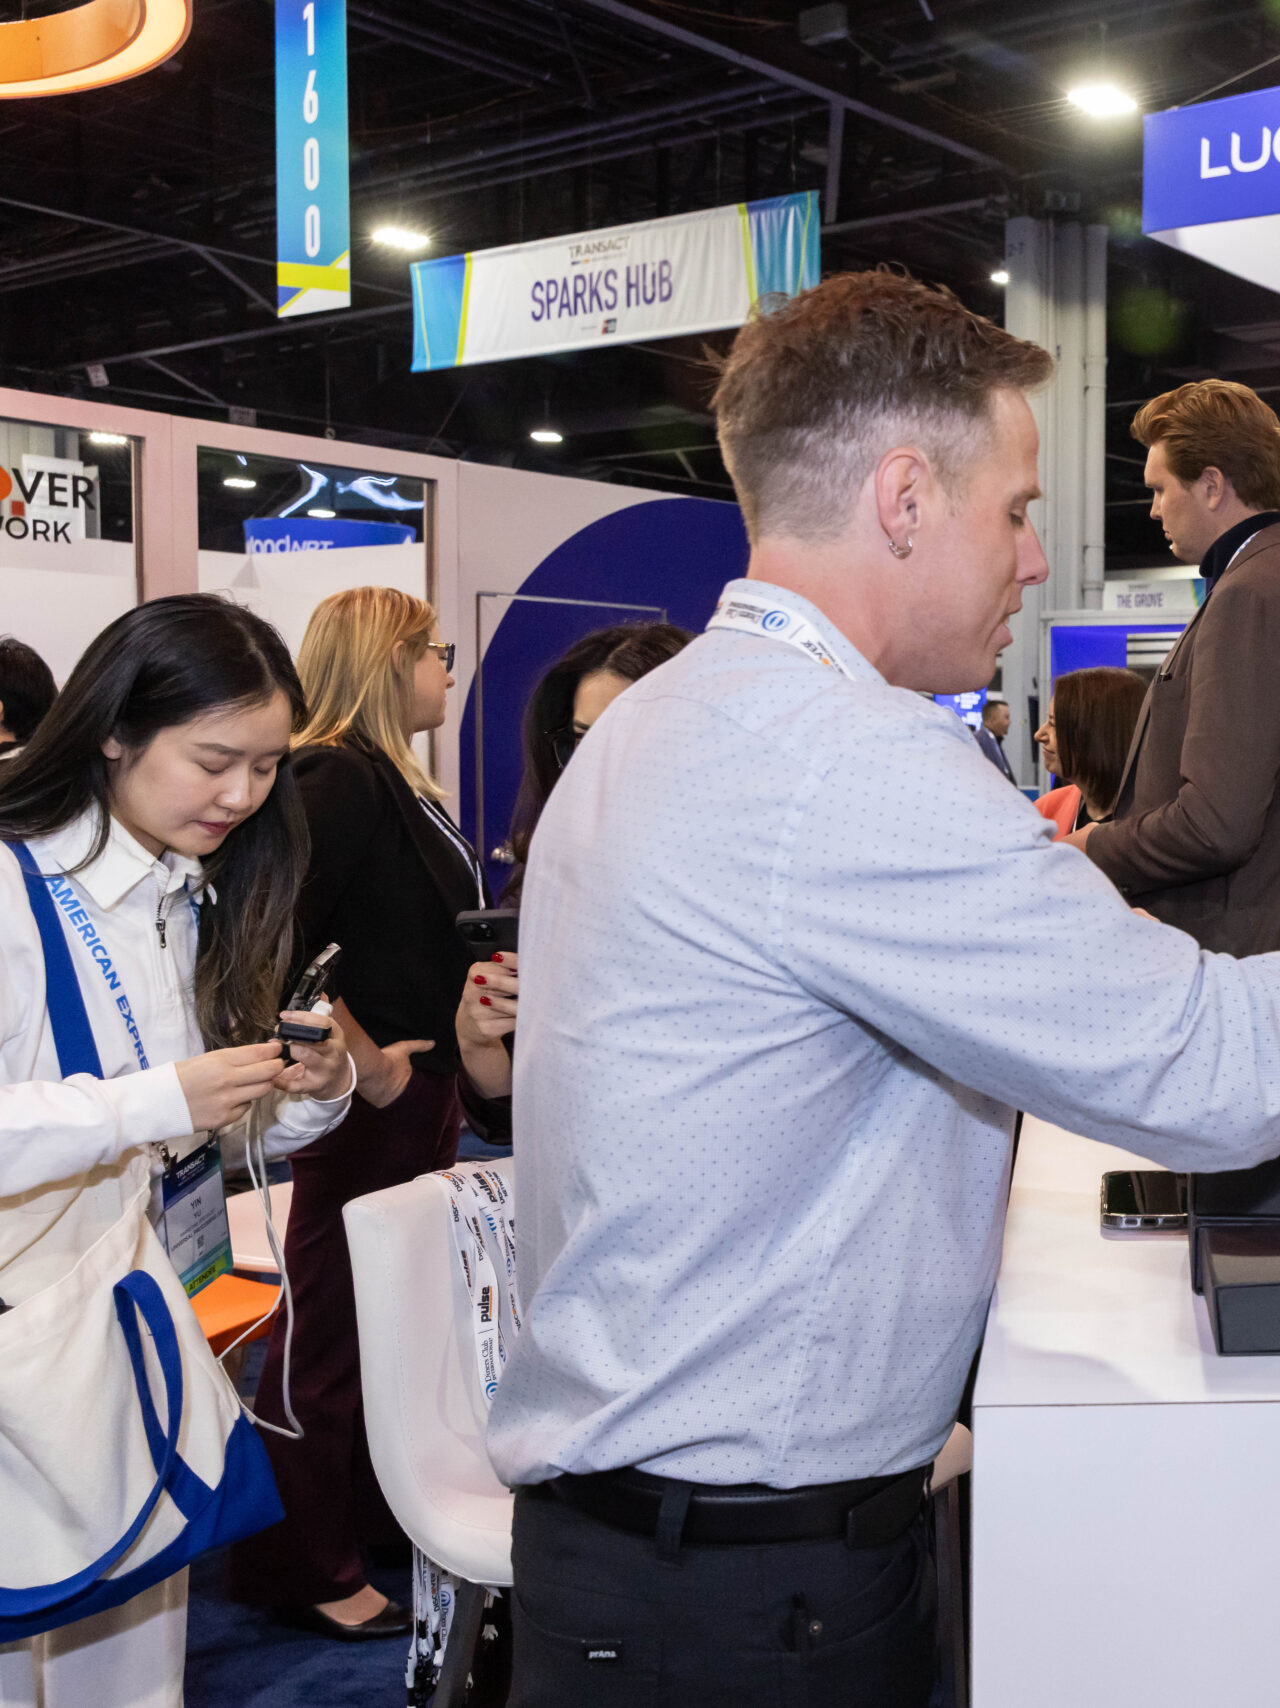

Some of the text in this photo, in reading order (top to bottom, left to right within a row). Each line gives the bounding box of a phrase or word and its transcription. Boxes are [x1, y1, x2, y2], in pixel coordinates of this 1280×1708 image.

[302, 2, 320, 258] 1600
[568, 236, 630, 259] TRANSACT
[531, 259, 673, 321] SPARKS HUB
[0, 515, 72, 544] ORK
[45, 876, 150, 1070] AMERICAN EXPRE
[176, 1153, 207, 1179] TRANSACT
[472, 1171, 498, 1203] pulse
[190, 1197, 202, 1209] YIN
[193, 1211, 201, 1220] YU
[188, 1265, 216, 1291] ATTENDEE
[477, 1285, 492, 1322] pulse
